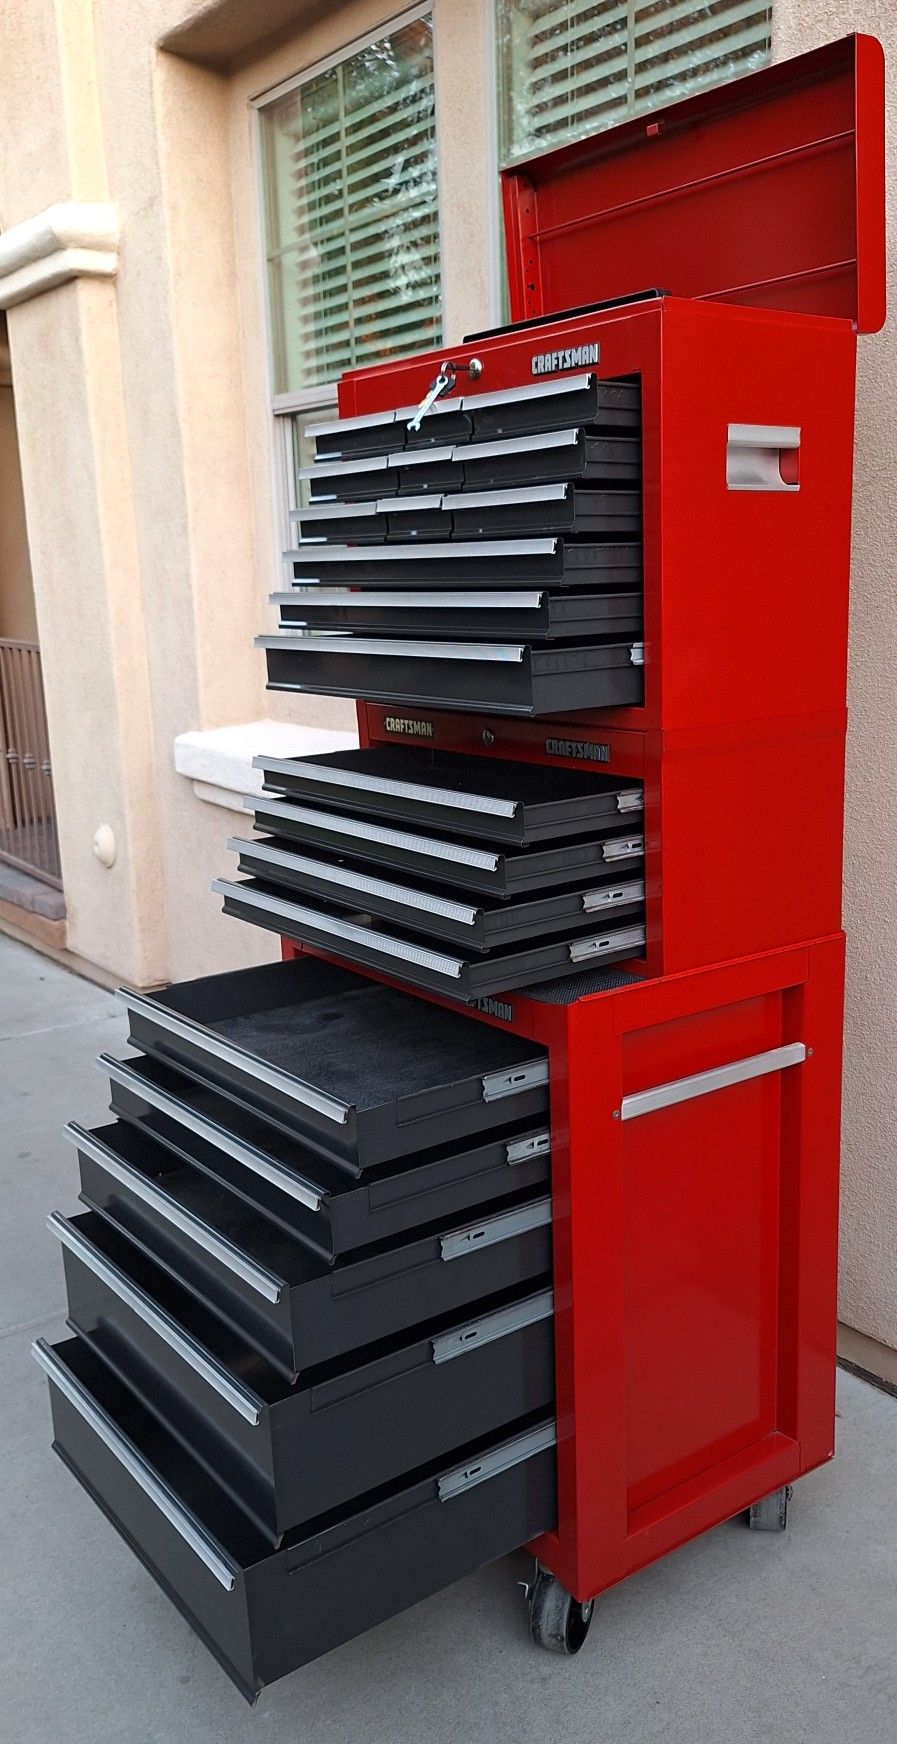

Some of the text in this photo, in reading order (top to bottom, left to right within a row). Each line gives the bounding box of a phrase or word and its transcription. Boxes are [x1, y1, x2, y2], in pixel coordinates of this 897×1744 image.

[531, 343, 599, 375] CRAFTSMAN
[385, 717, 432, 736] CRAFTSMAN
[545, 738, 610, 762] CRAFTSMAN
[467, 997, 512, 1021] TSMAN
